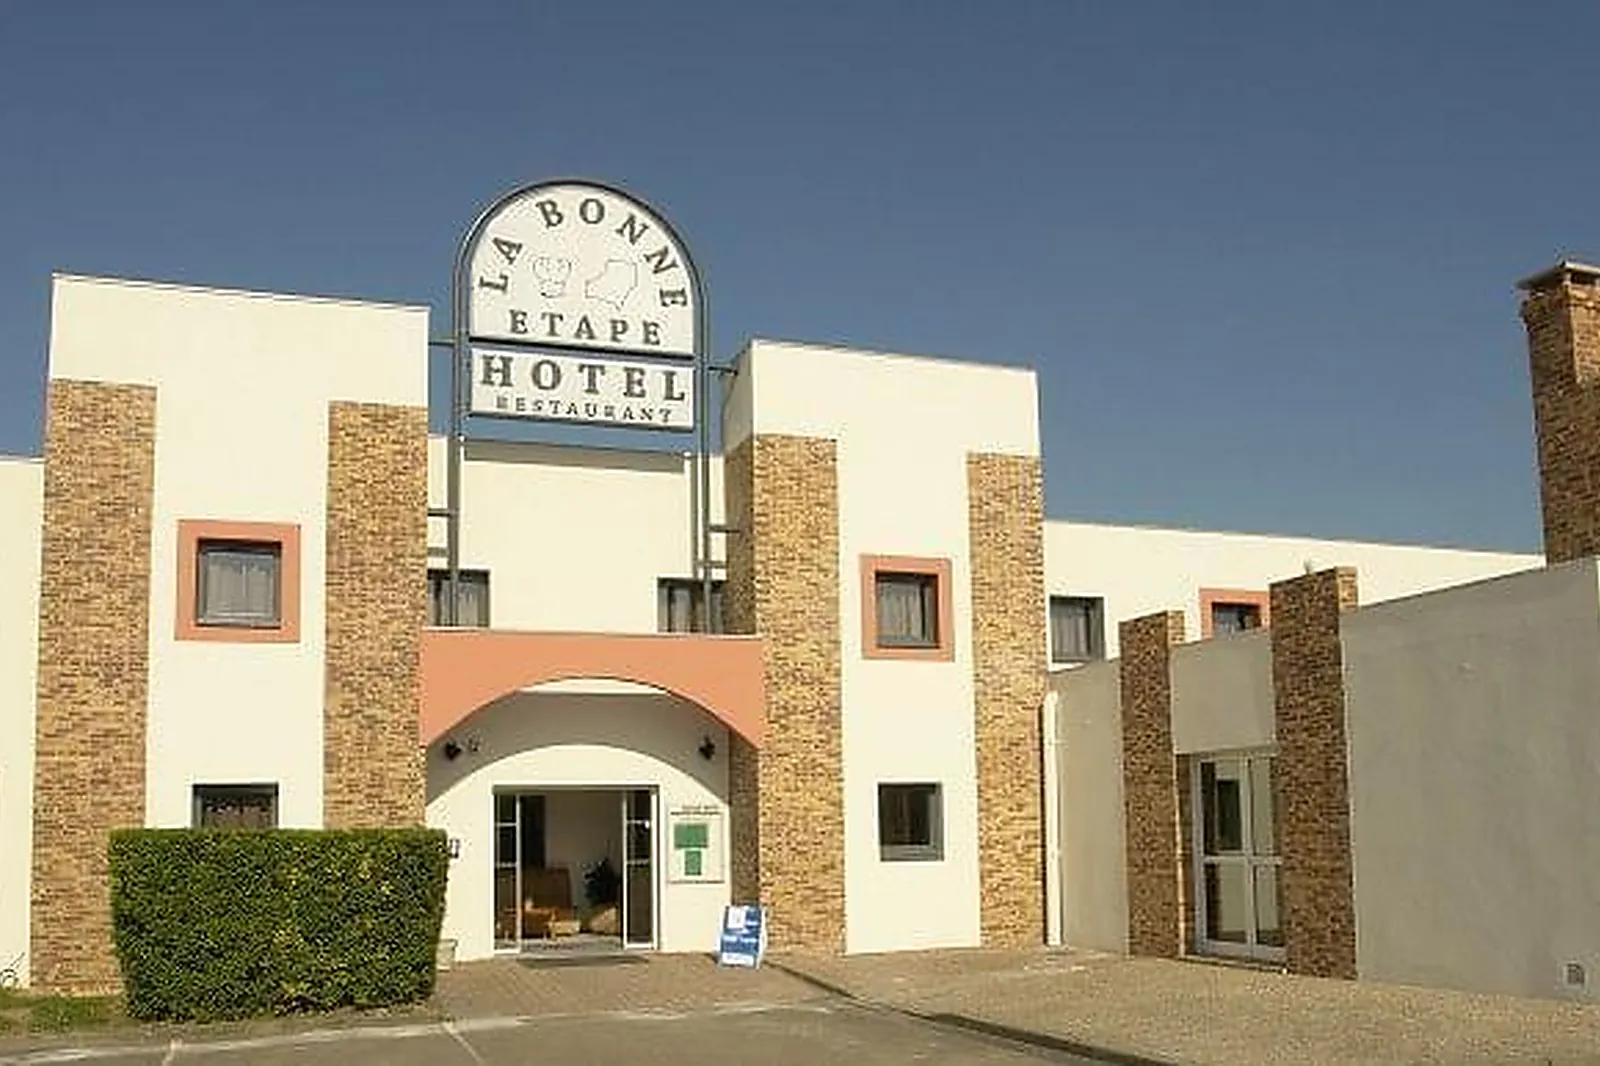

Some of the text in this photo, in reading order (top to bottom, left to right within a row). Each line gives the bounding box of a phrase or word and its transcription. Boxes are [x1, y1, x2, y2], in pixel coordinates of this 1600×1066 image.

[479, 198, 688, 307] LA BONNE
[509, 309, 662, 346] ETAPE
[480, 354, 686, 402] HOTEL
[496, 396, 672, 424] RESTAURANT
